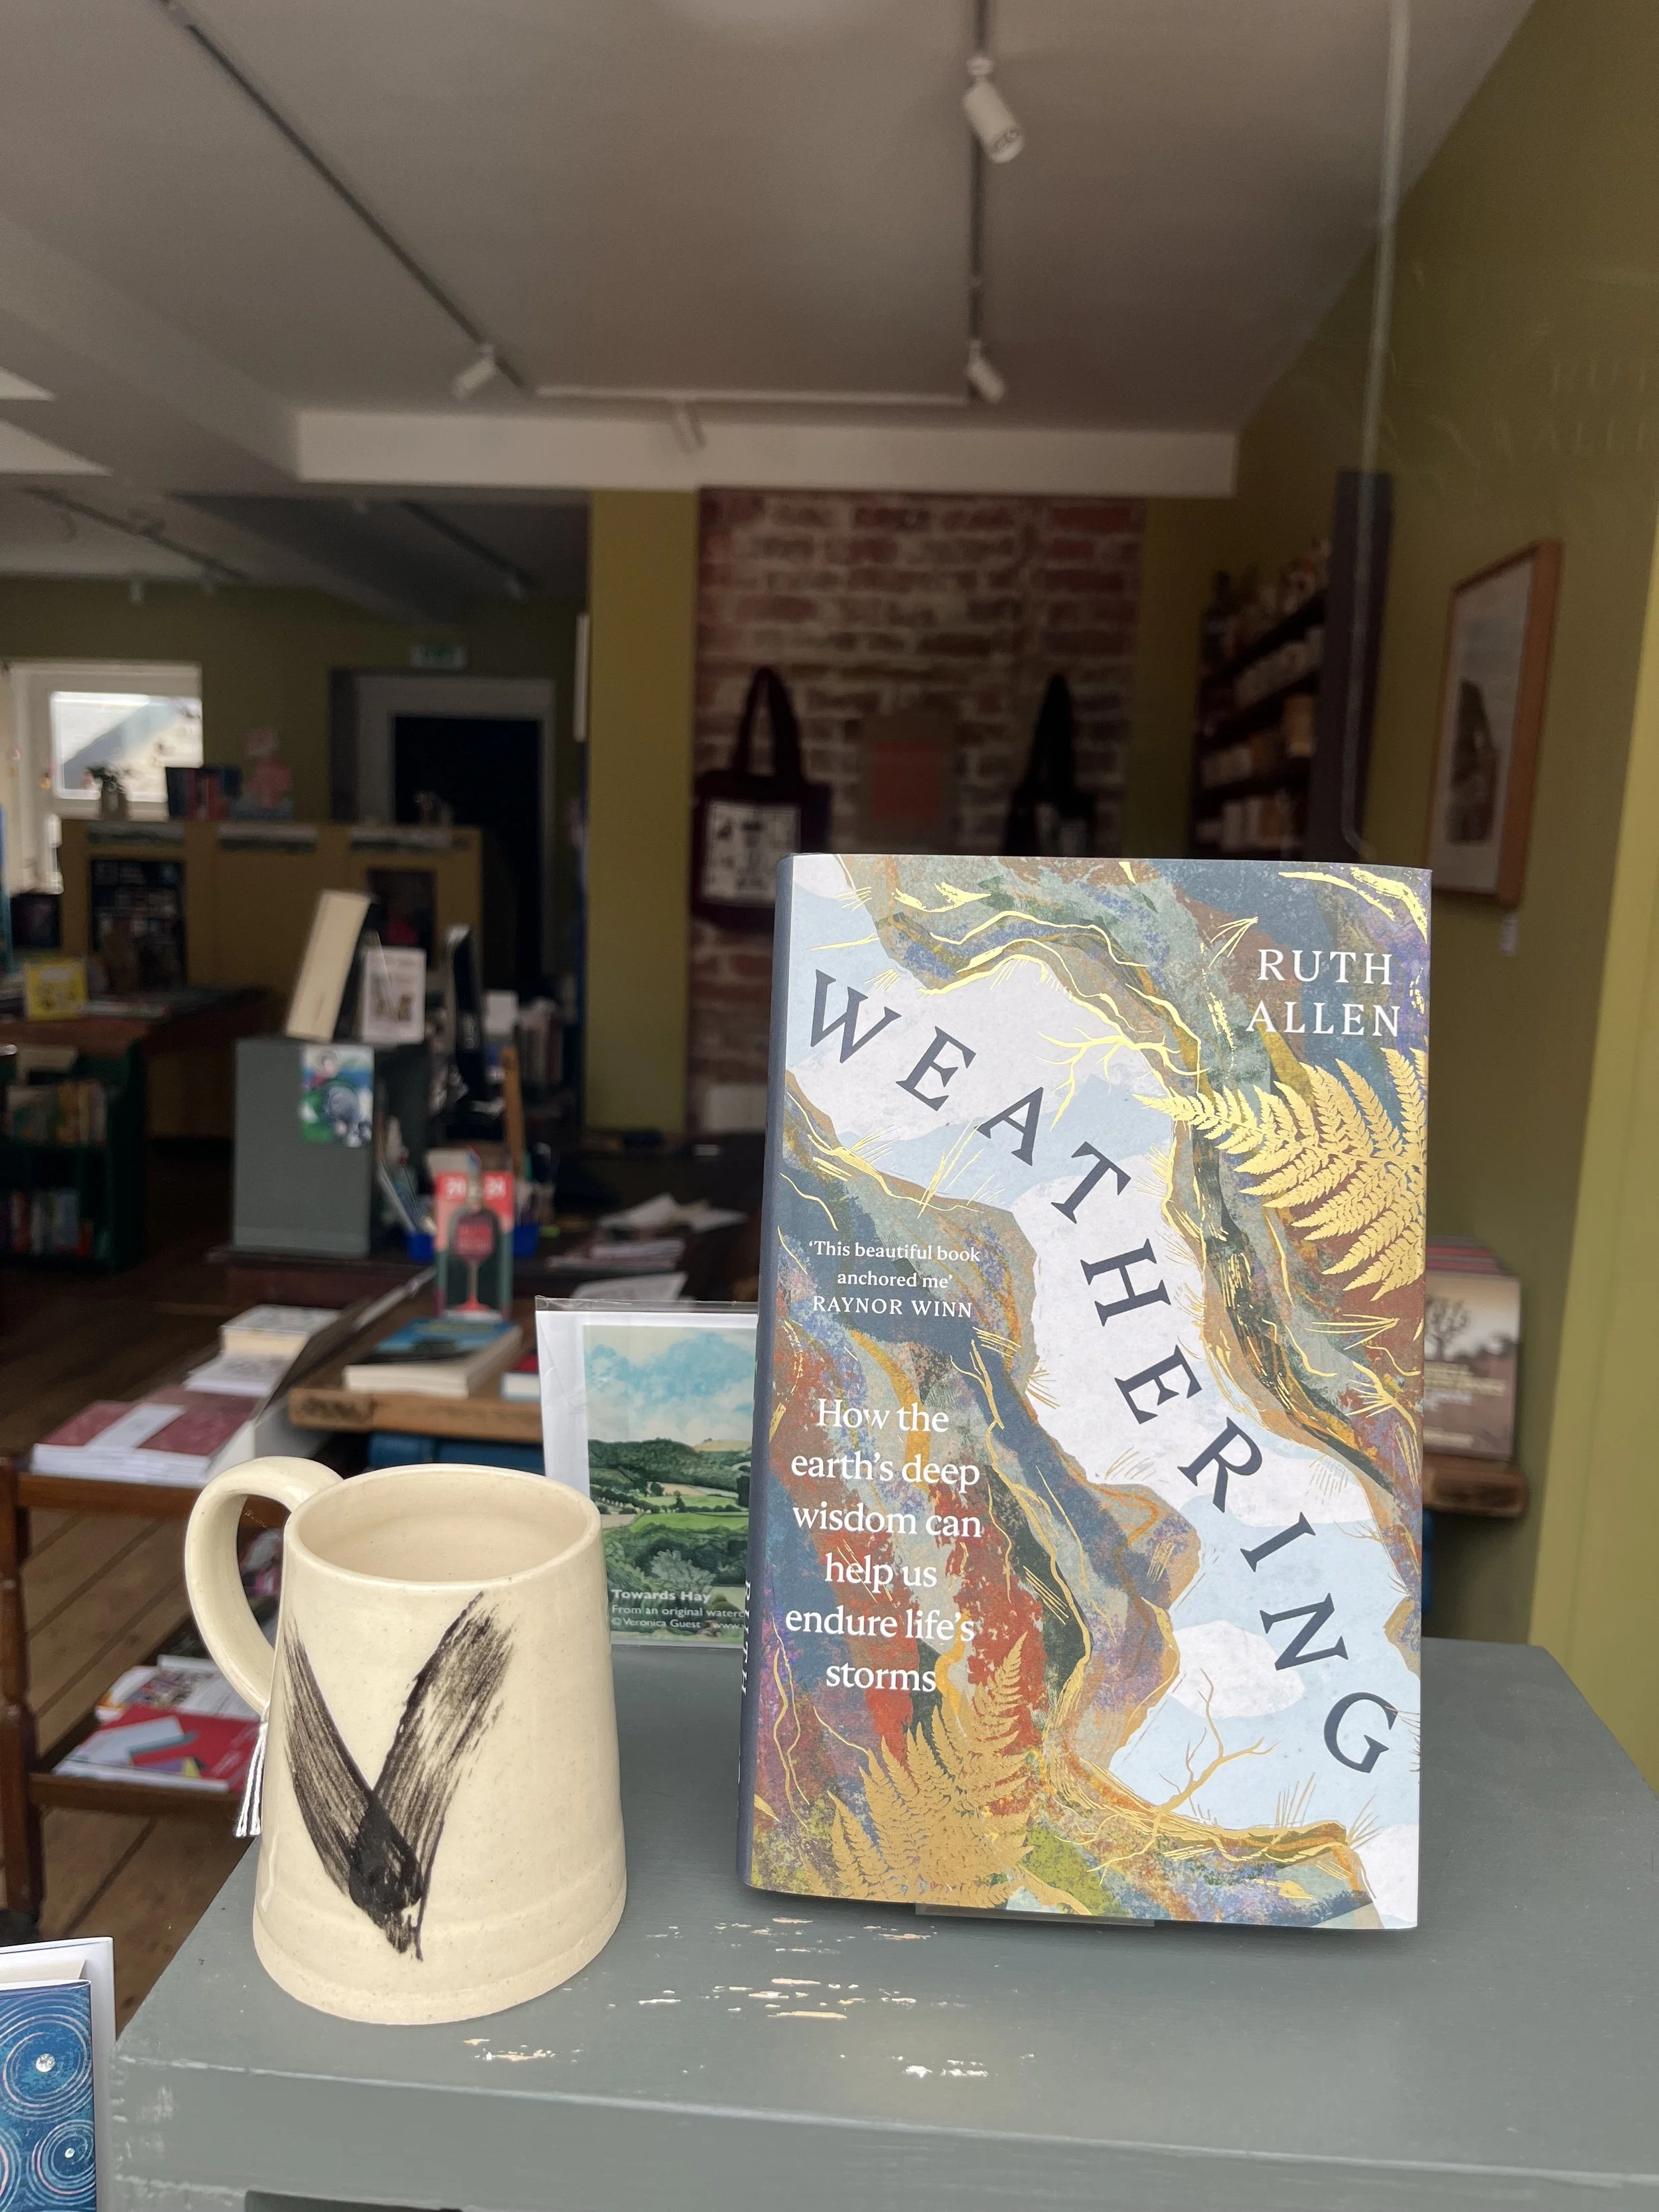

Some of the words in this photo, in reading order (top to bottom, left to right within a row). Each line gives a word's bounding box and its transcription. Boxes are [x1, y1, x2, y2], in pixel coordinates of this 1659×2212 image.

[1258, 949, 1392, 985] RUTH
[1246, 1000, 1400, 1037] ALLEN
[855, 1242, 932, 1260] beautiful
[937, 1246, 980, 1262] book
[837, 1270, 917, 1288] anchored
[813, 1295, 902, 1315] RAYNOR
[911, 1300, 972, 1318] WINN
[809, 968, 1398, 1773] WEATHERING
[816, 1398, 890, 1429] How
[897, 1402, 949, 1432] the
[791, 1453, 894, 1481] earth’s
[902, 1454, 980, 1495] deep
[793, 1504, 918, 1534] wisdom
[925, 1516, 982, 1538] can
[824, 1552, 894, 1594] help
[902, 1566, 937, 1588] us
[611, 1589, 676, 1601] Towards
[681, 1591, 711, 1603] Hay
[612, 1605, 642, 1615] From
[662, 1607, 703, 1618] original
[670, 1619, 701, 1629] Guest
[785, 1606, 898, 1636] endure
[905, 1609, 975, 1641] life’s
[826, 1664, 936, 1693] storms
